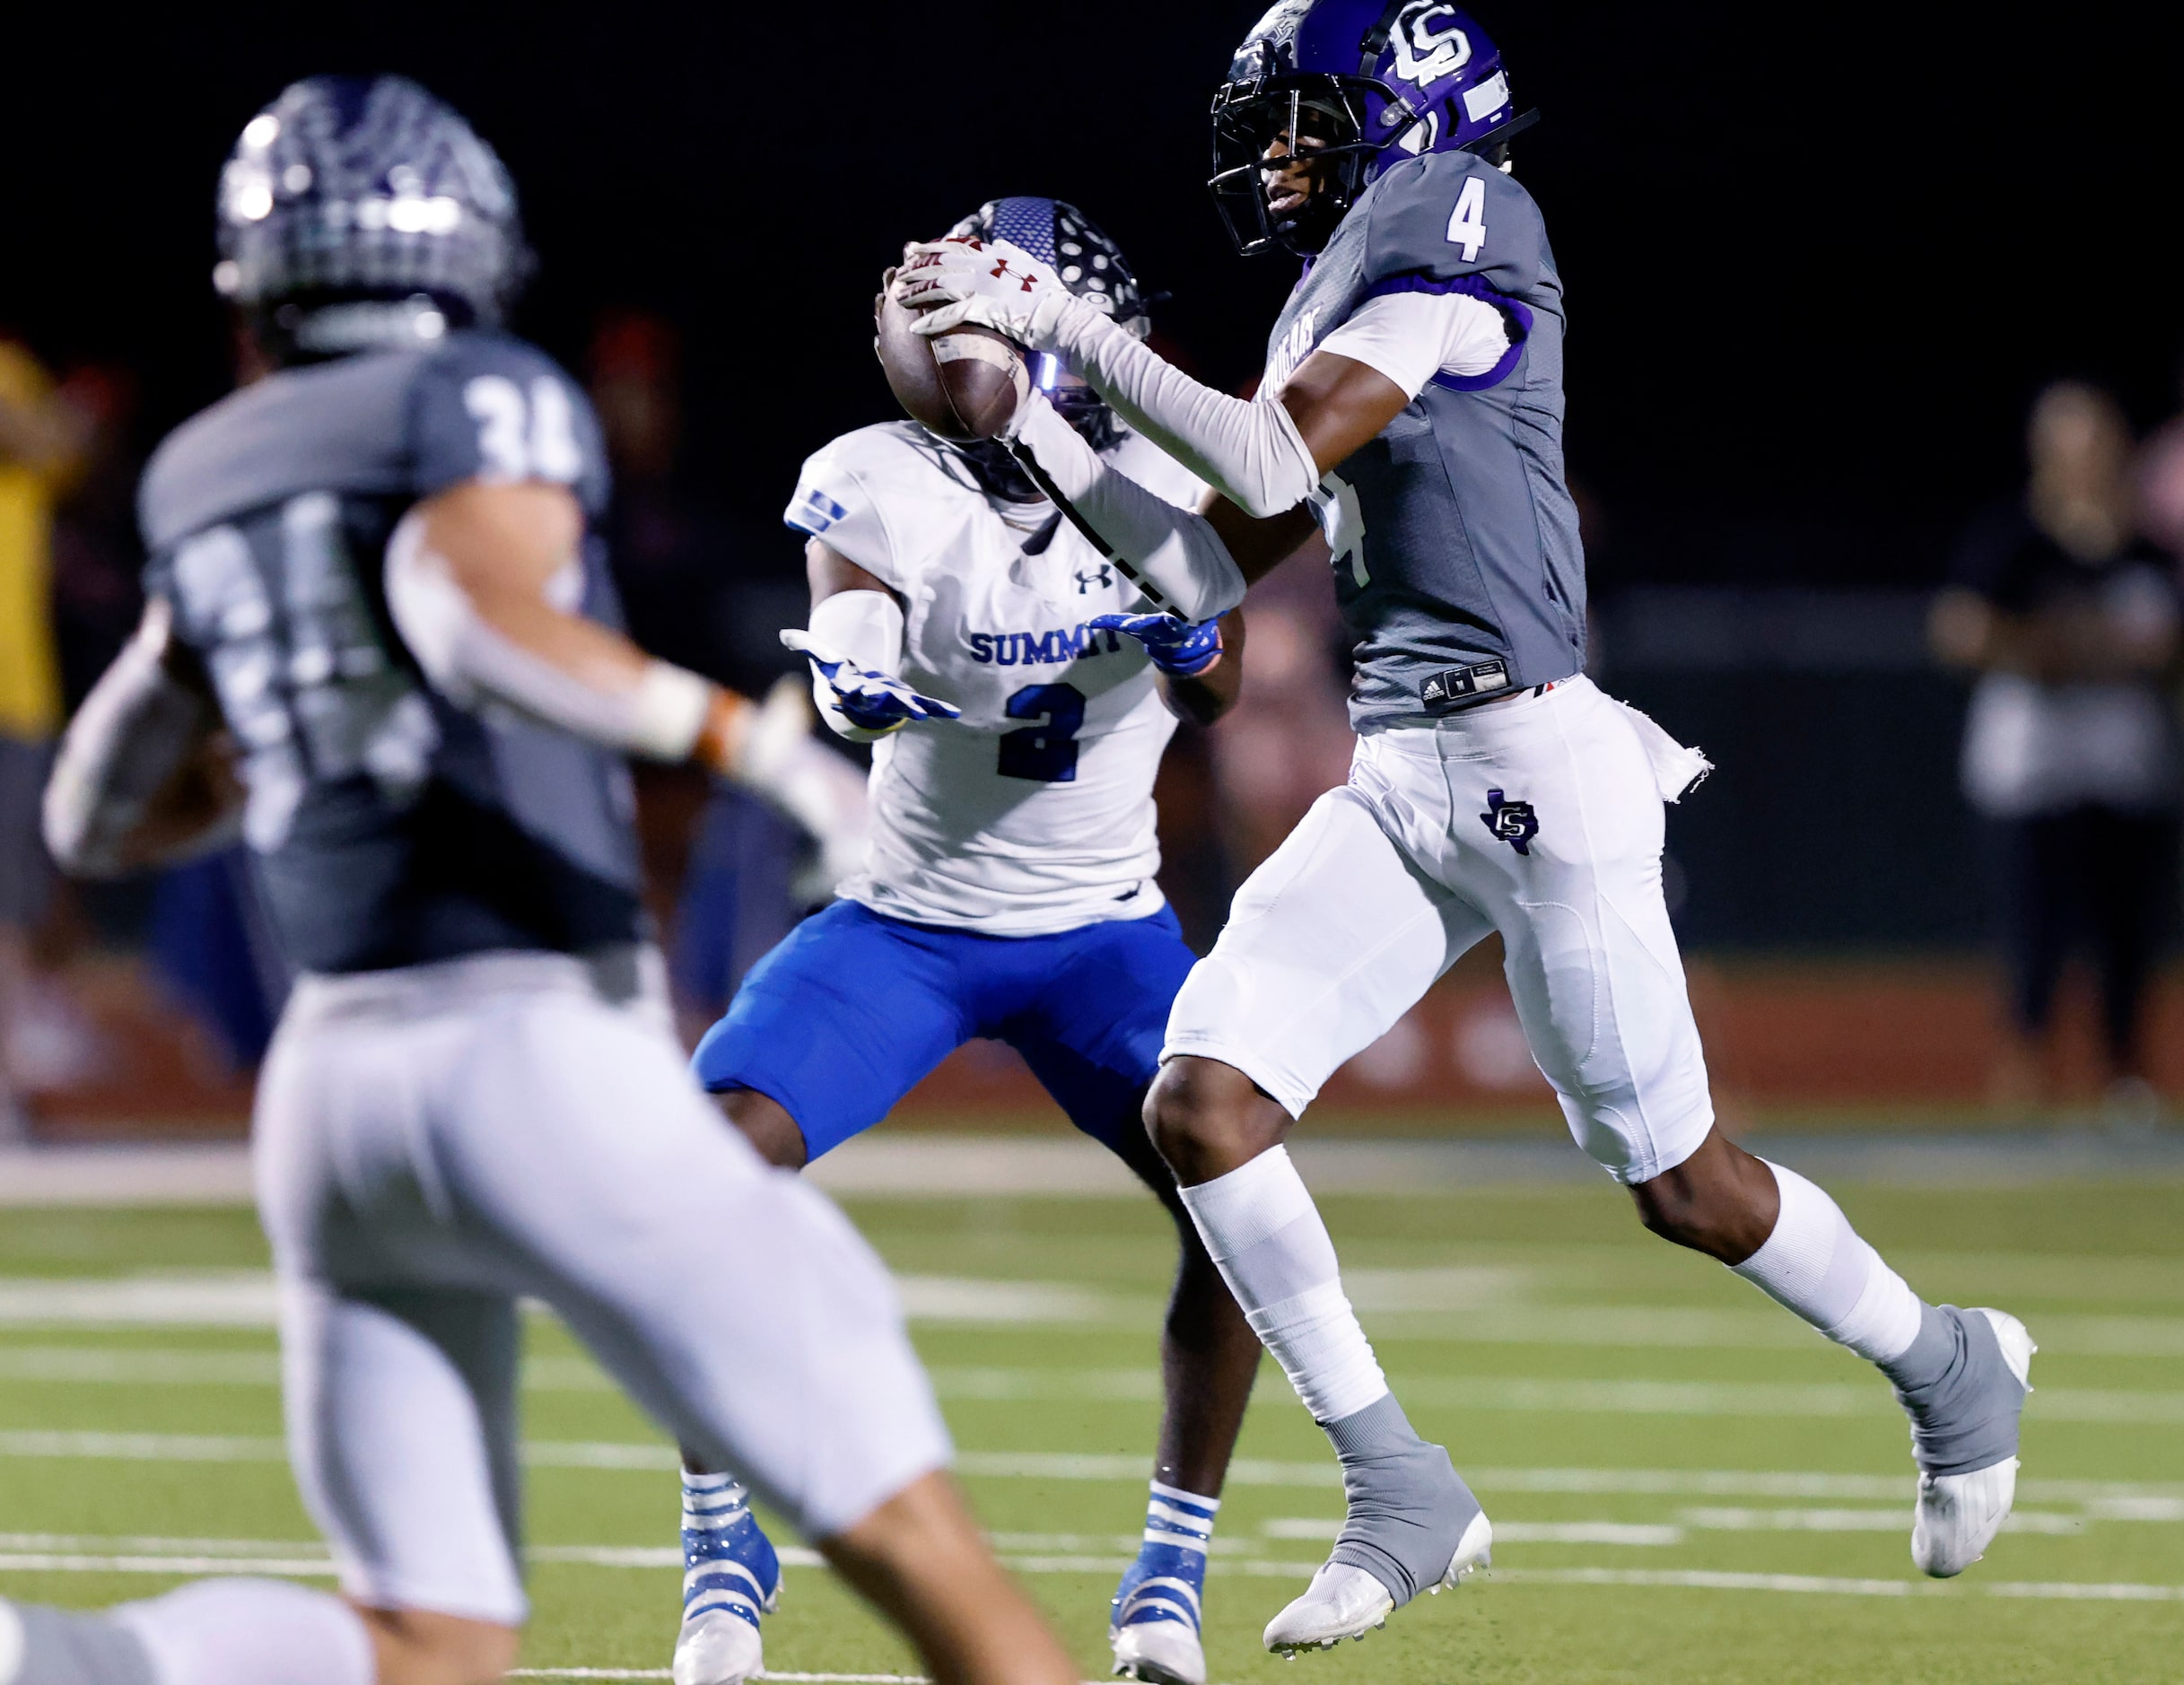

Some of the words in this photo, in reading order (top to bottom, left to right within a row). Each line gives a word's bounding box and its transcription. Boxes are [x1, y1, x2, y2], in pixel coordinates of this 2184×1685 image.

[1447, 176, 1487, 263] 4
[998, 682, 1087, 782] 2
[1422, 689, 1446, 701] adidas
